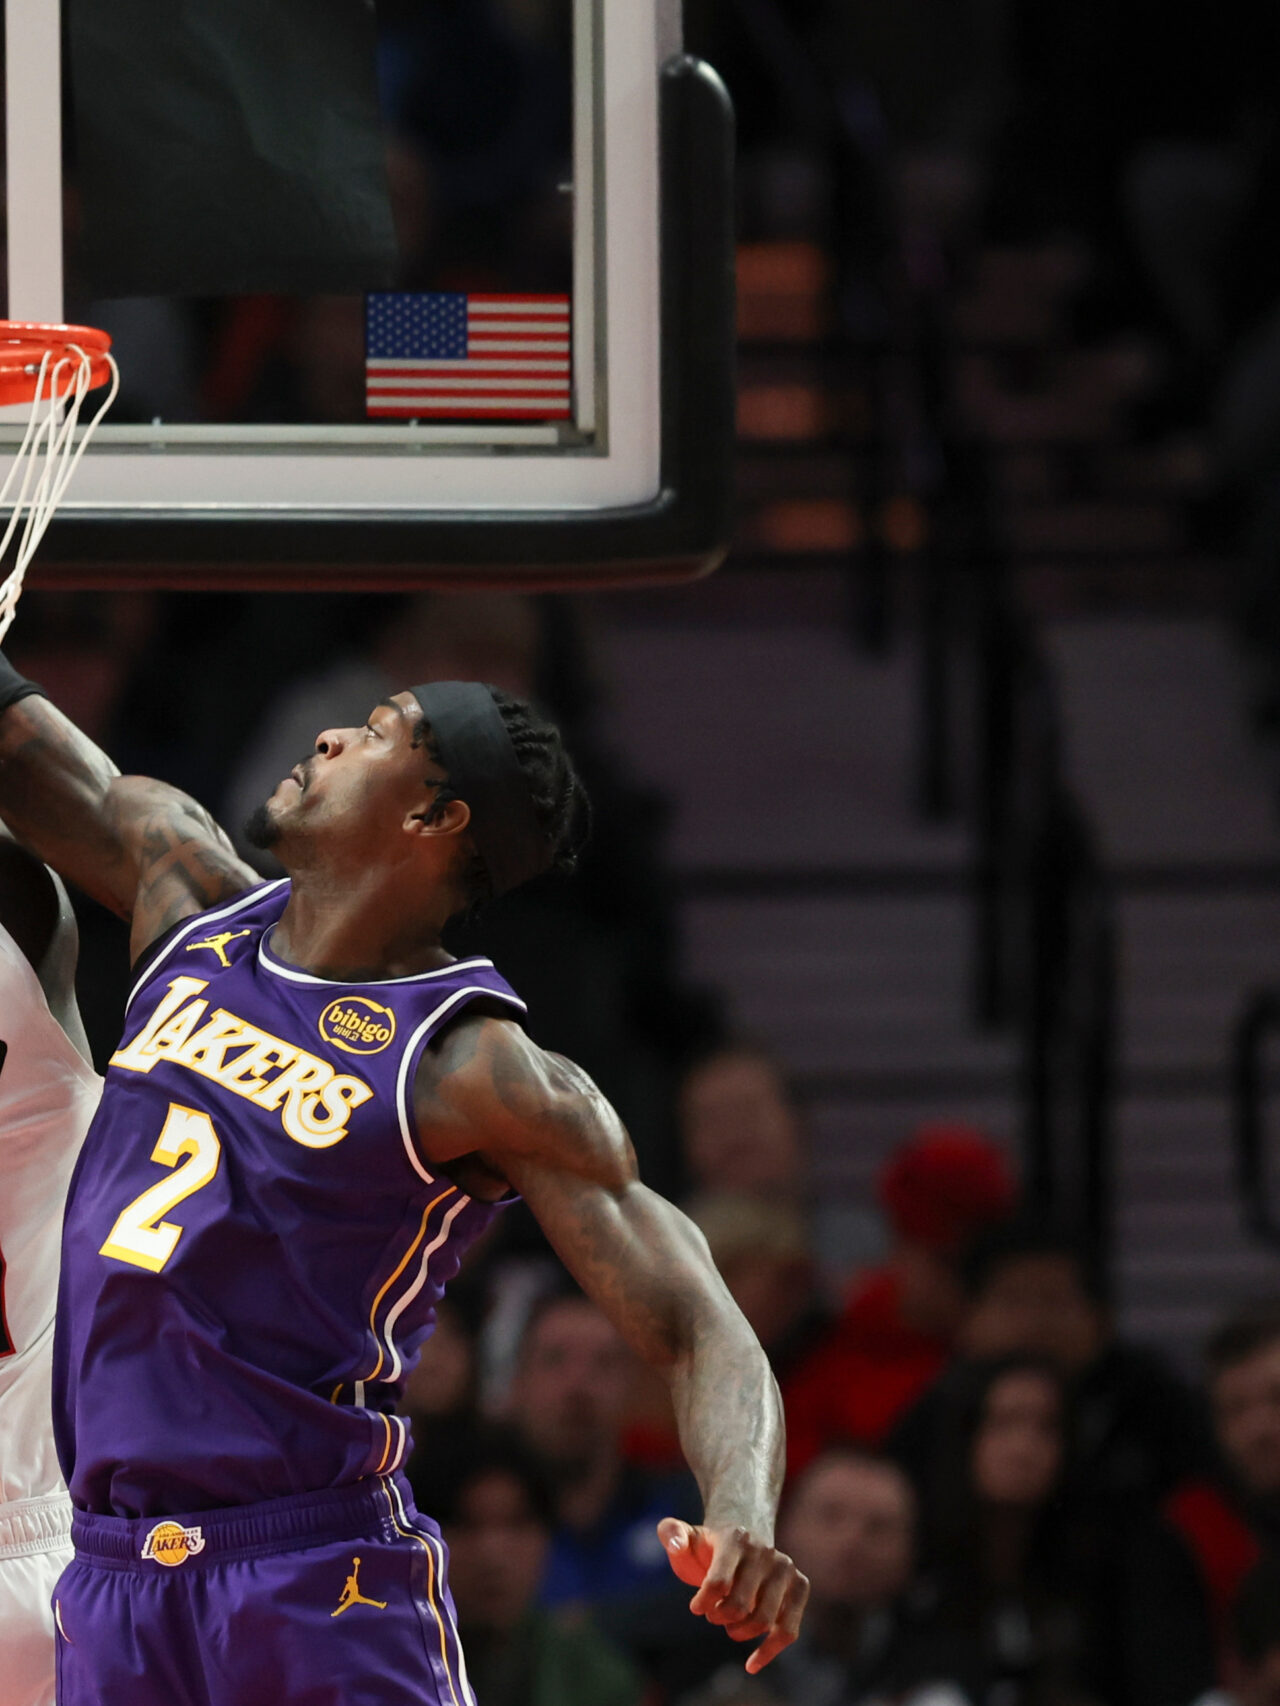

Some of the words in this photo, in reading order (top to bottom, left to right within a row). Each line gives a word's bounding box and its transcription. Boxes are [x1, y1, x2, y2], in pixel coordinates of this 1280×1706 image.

[108, 975, 374, 1149] LAKERS
[328, 1005, 390, 1043] bibigo
[98, 1102, 221, 1274] 2
[144, 1534, 202, 1556] LAKERS
